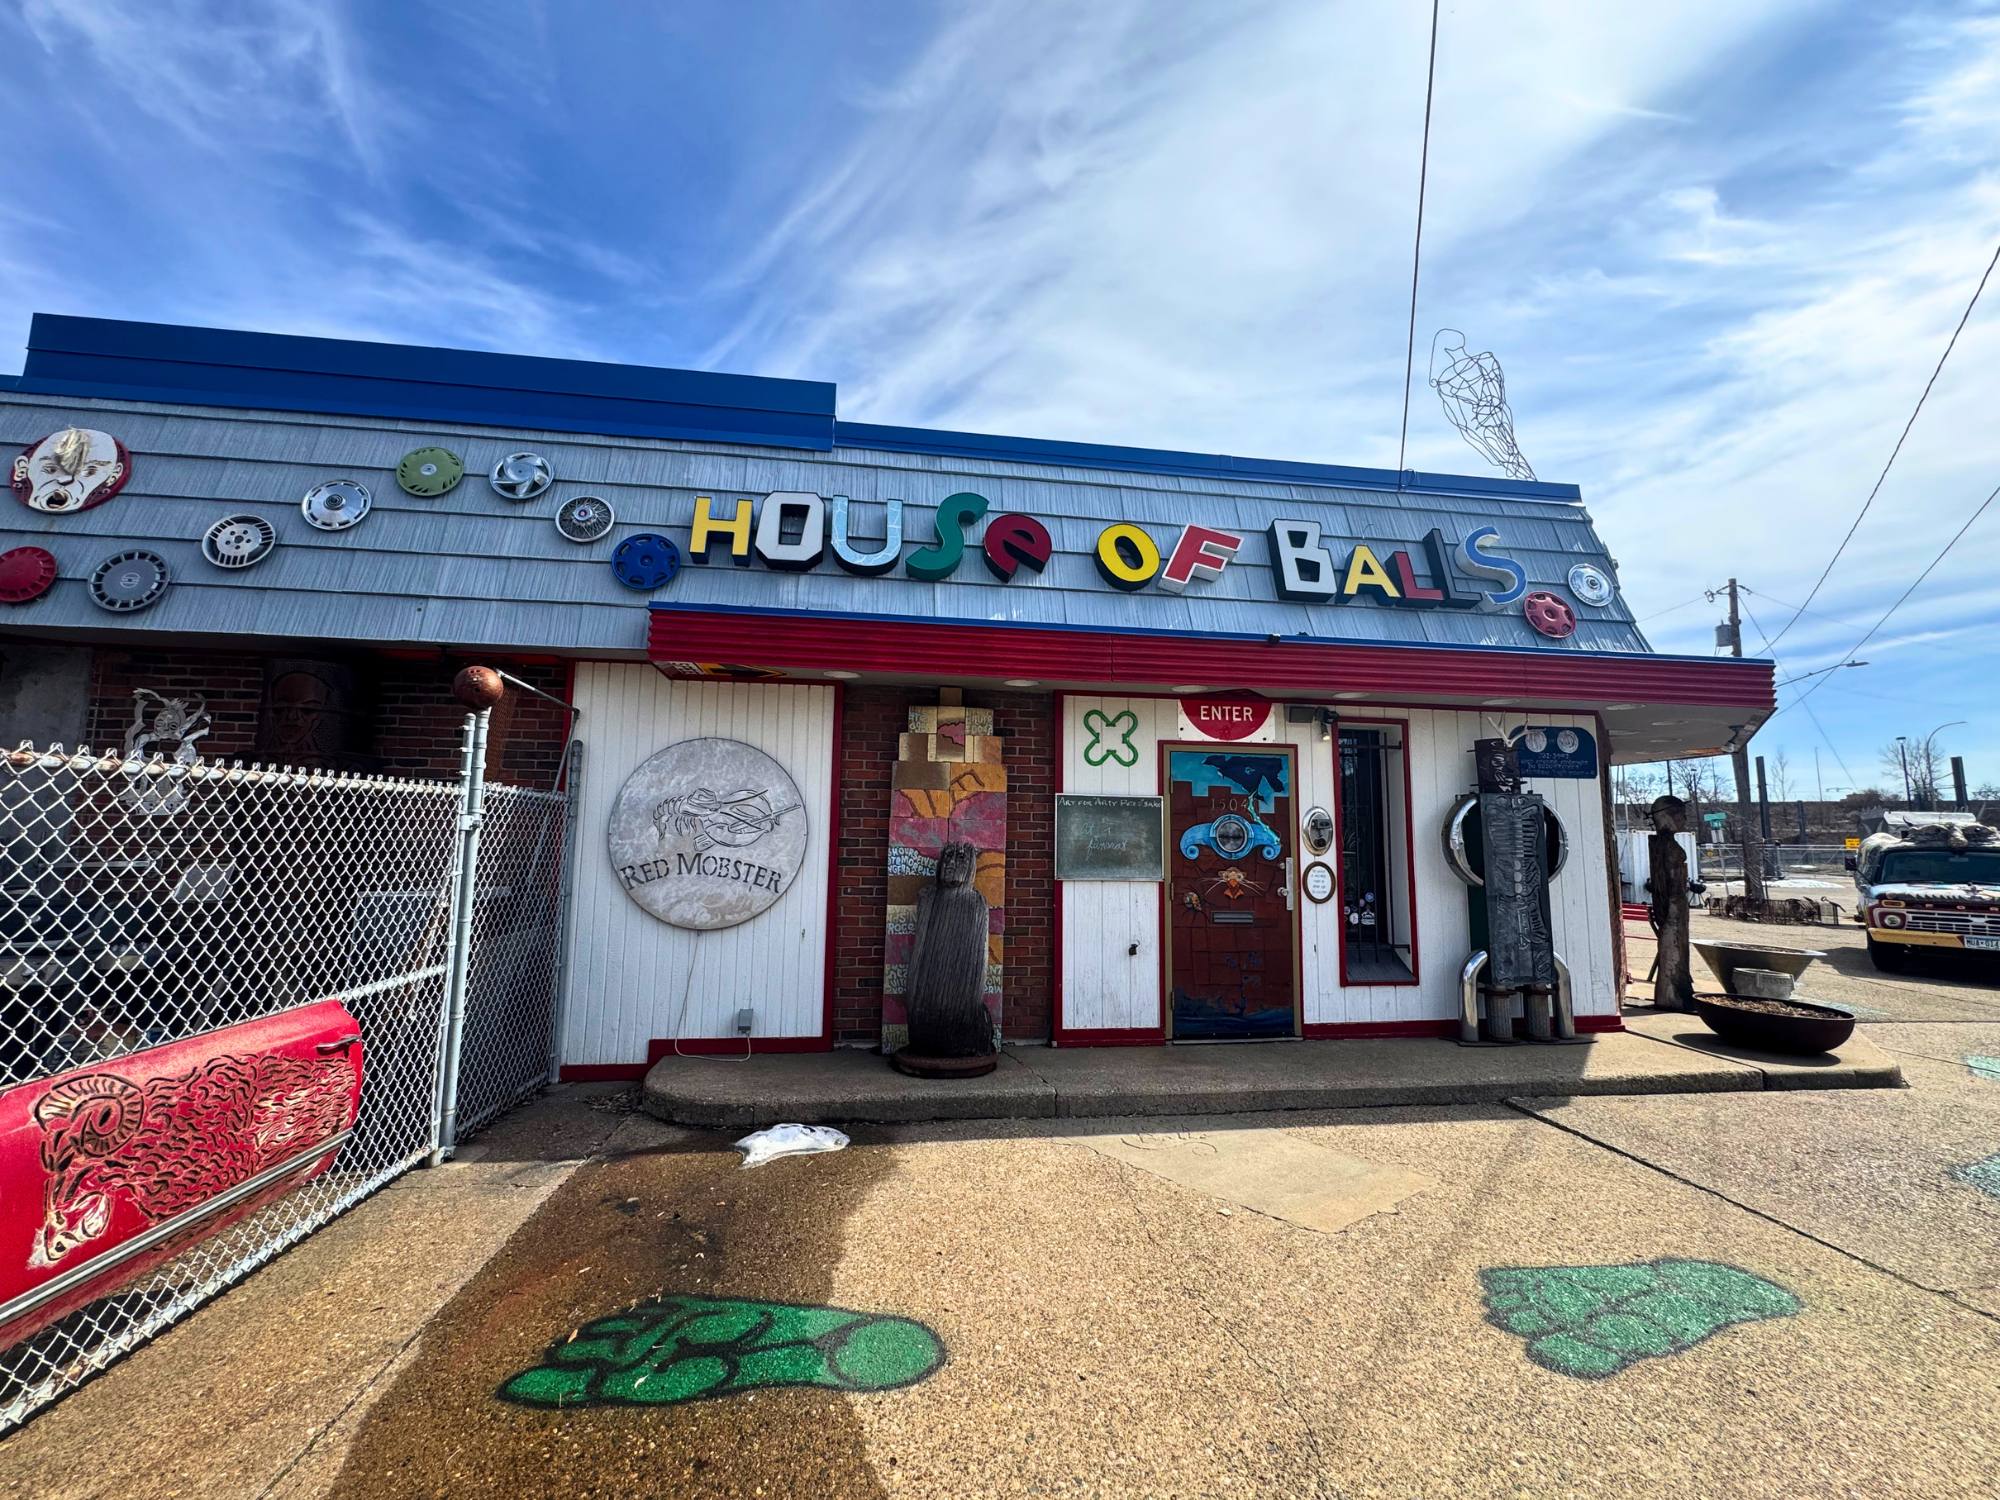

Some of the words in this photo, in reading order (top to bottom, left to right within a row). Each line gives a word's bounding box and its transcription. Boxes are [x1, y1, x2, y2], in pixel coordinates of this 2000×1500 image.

[1093, 520, 1243, 596] OF
[1267, 517, 1527, 614] BALLS
[1200, 705, 1253, 722] ENTER
[1211, 798, 1249, 811] 1504
[620, 857, 670, 891] RED
[677, 852, 783, 894] MOBSTER
